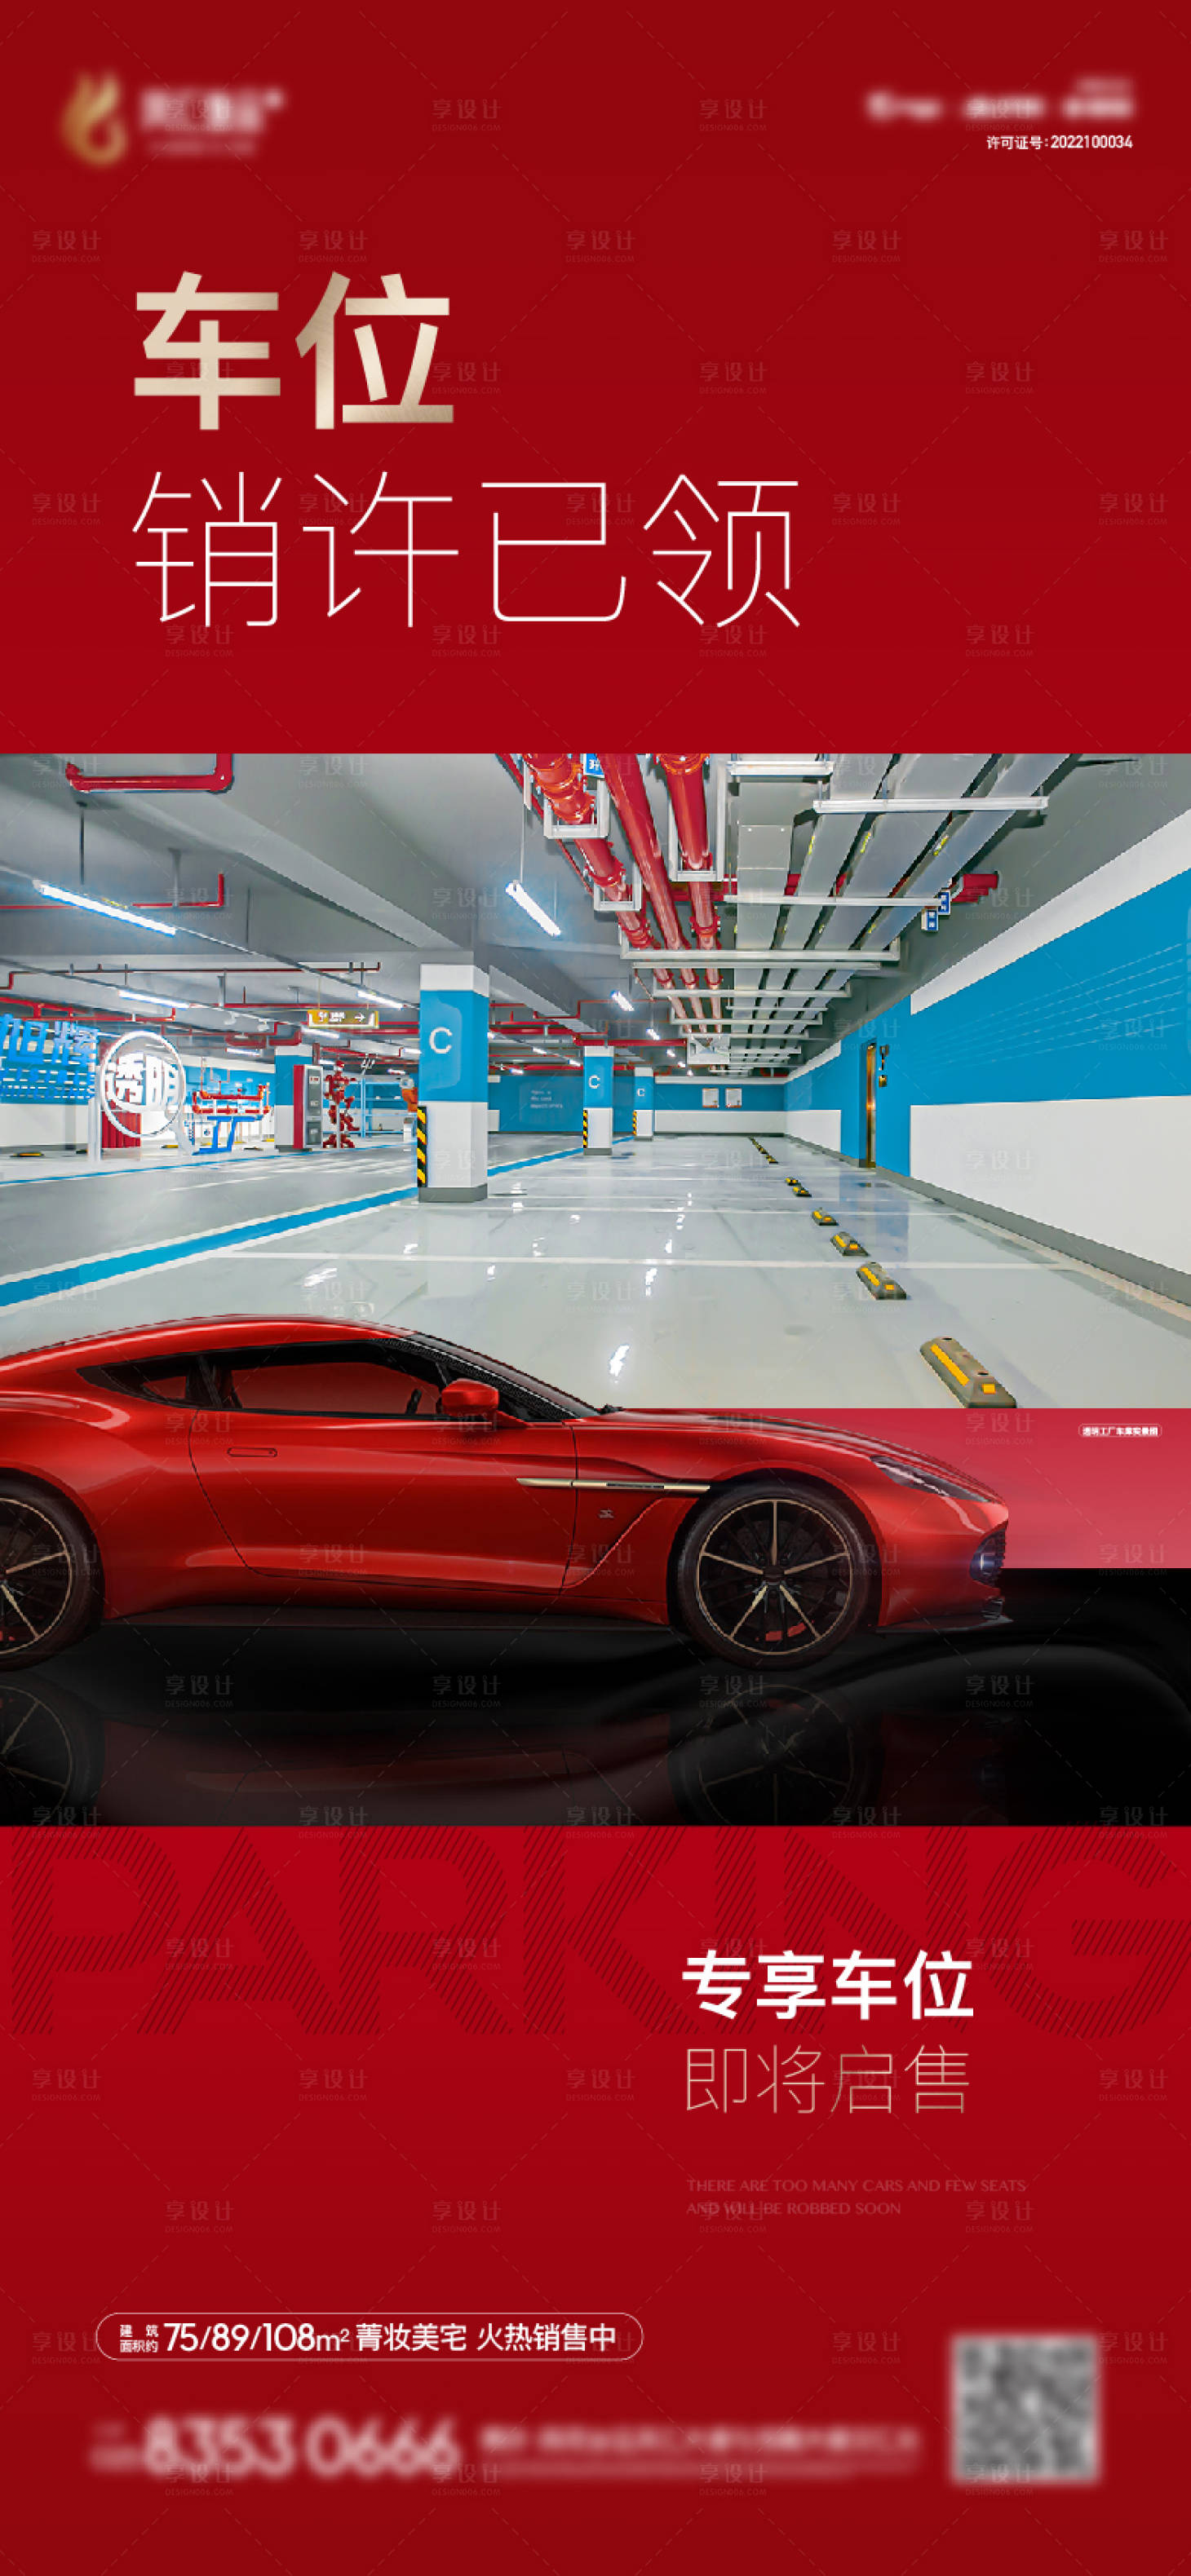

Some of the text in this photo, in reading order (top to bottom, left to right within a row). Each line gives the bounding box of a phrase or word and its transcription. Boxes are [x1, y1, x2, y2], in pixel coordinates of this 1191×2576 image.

[986, 135, 1134, 150] 许可证号:2022100034
[134, 271, 454, 431] 车位
[132, 471, 800, 628] 销许已领
[429, 1027, 453, 1055] C
[588, 1074, 601, 1090] C
[636, 1087, 646, 1098] C
[681, 1949, 974, 2021] 专享车位
[686, 2044, 970, 2114] 即将启售
[687, 2179, 1026, 2193] THERE ARE TOO MANY CARS AND FEW SEATS
[686, 2202, 901, 2216] AND WILL BE ROBBED SOON
[119, 2339, 159, 2353] 面积约
[356, 2322, 467, 2352] 菁妆美宅
[476, 2322, 616, 2352] 火热销售中
